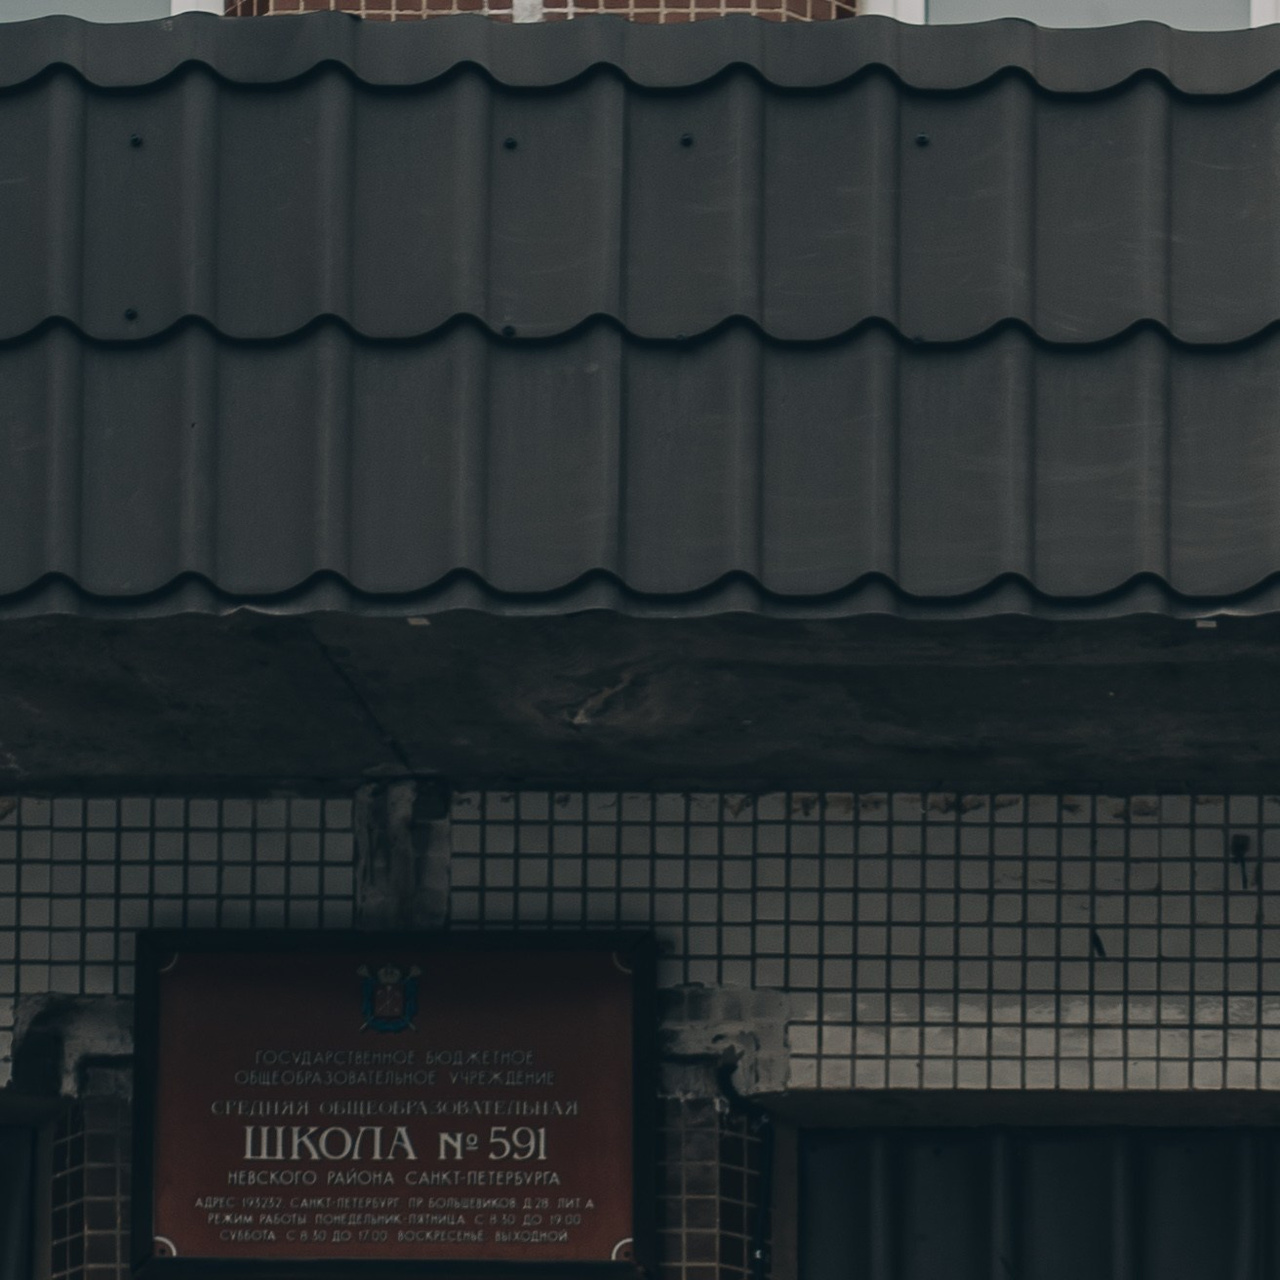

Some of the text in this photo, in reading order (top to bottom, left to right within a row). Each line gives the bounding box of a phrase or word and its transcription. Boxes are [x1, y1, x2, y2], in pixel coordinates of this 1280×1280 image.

[255, 1050, 535, 1066] ГОСУДАРСТВЕННОЕ БЮДЖЕТНОЕ
[234, 1070, 556, 1086] ОБЩЕОБРАЗОВАТЕЛЬНОЕ УЧРЕЖДЕНИЕ
[210, 1100, 579, 1116] СРЕДНЯЯ ОБЩЕОБРАЗОВАТЕЛЬНАЯ
[243, 1125, 548, 1160] ШКОЛА № 591
[227, 1167, 561, 1186] НЕВСКОГО РАЙОНА САНКТ-ПЕТЕРБУРГА
[207, 1213, 254, 1225] РЕЖИМ
[521, 1213, 543, 1227] ДО
[331, 1229, 352, 1243] ДО
[495, 1228, 569, 1243] ВЫХОДНОЙ
